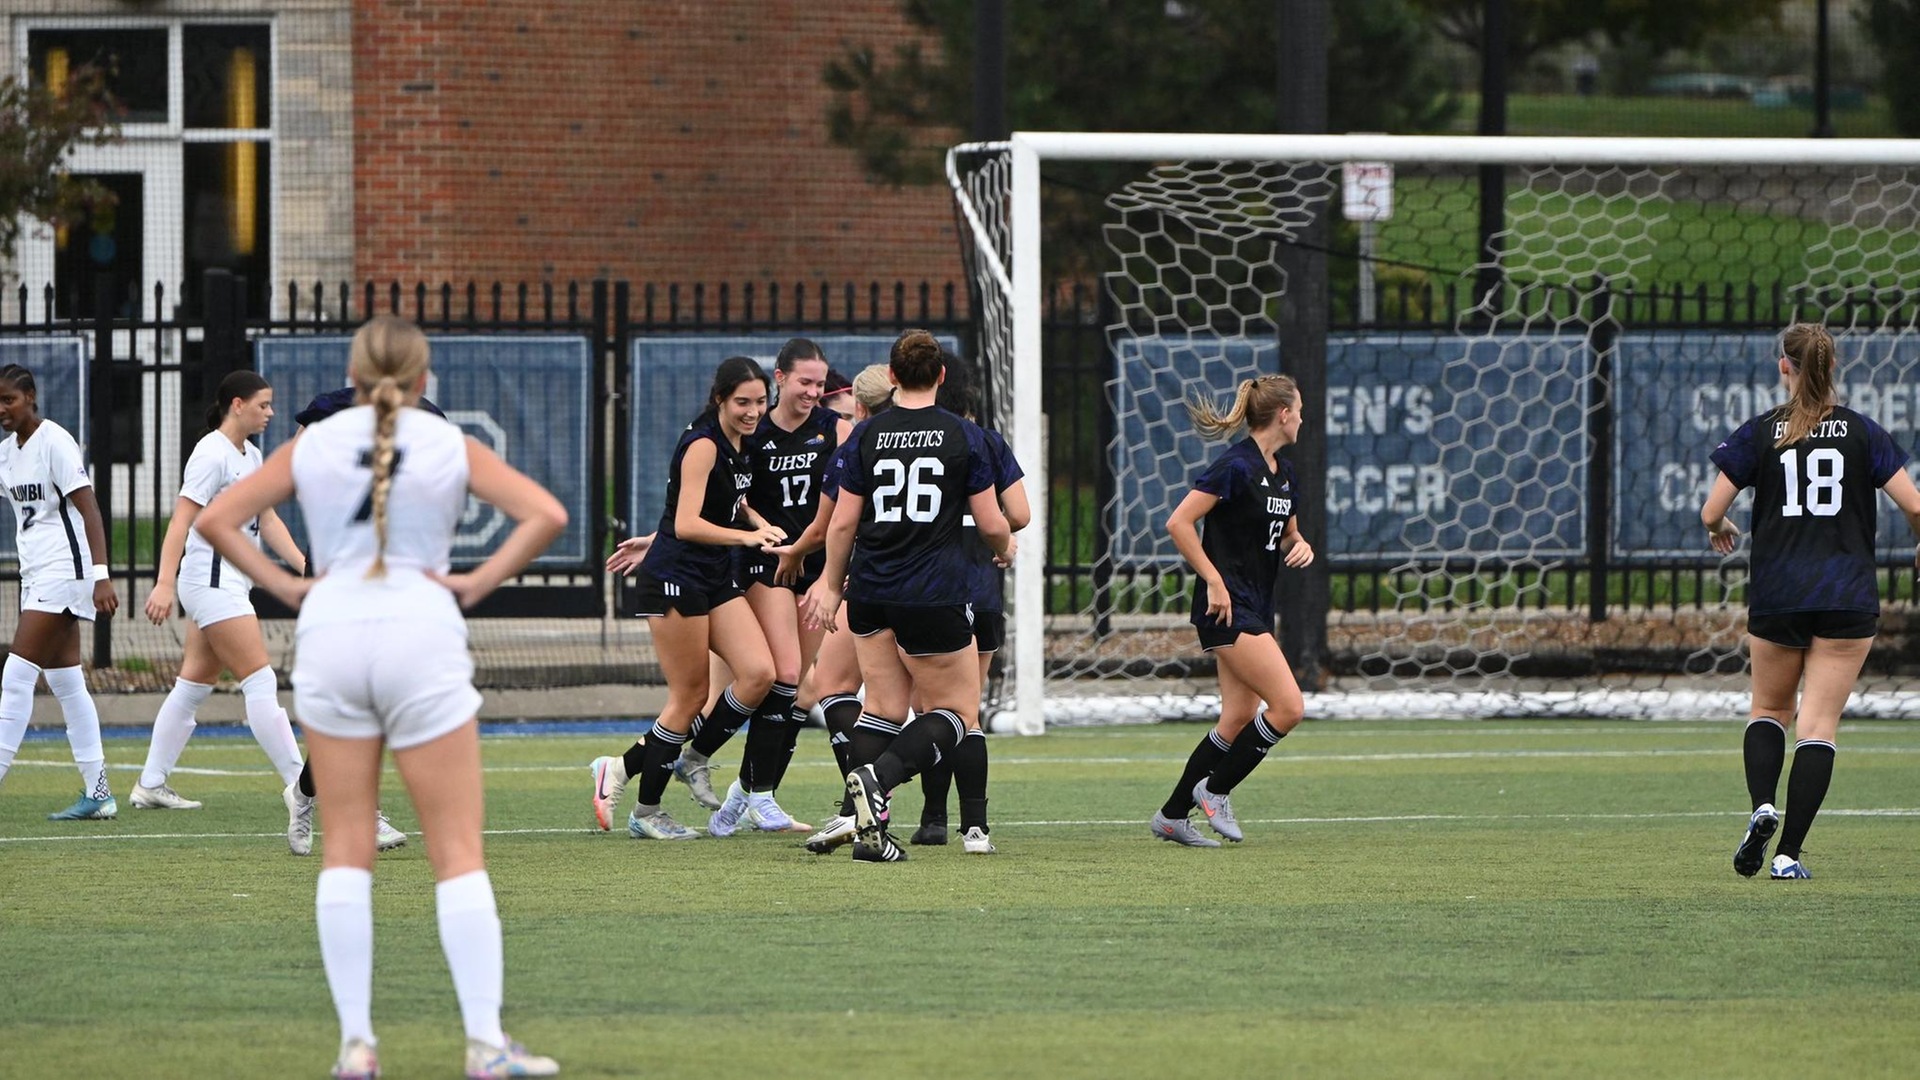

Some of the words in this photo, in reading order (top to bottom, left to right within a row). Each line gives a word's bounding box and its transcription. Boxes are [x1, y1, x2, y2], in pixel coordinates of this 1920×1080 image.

[1326, 384, 1434, 435] EN'S
[875, 430, 945, 450] EUTECTICS
[769, 452, 818, 472] UHSP
[780, 474, 811, 508] 17
[872, 457, 945, 523] 26
[1326, 464, 1446, 514] CCER
[1780, 448, 1845, 517] 18
[21, 506, 37, 531] 2
[1266, 496, 1292, 516] UHSP
